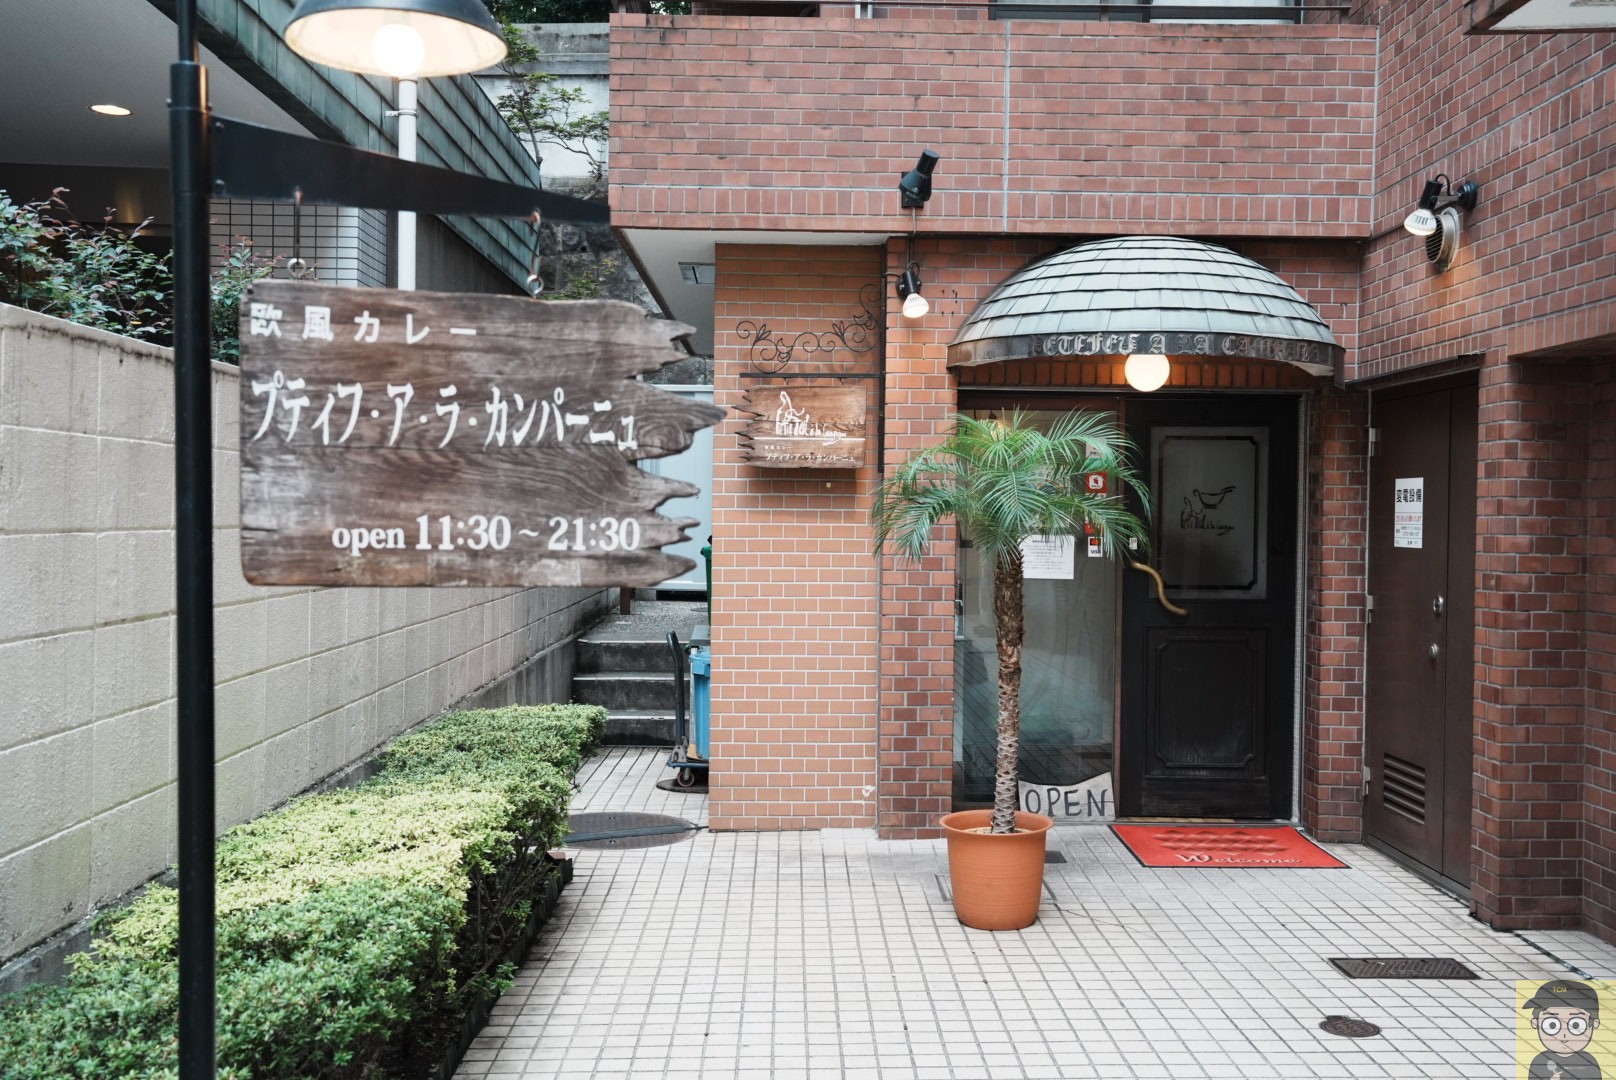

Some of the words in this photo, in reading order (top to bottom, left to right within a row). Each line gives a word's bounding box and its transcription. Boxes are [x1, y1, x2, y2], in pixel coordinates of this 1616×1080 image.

[249, 302, 477, 345] 欧風カレー
[1149, 333, 1168, 354] A
[1177, 334, 1213, 355] LA
[332, 523, 405, 556] open
[416, 514, 511, 551] 11:30
[548, 516, 640, 552] 21:30
[1025, 787, 1110, 817] OPEN
[1175, 853, 1302, 864] Welcome
